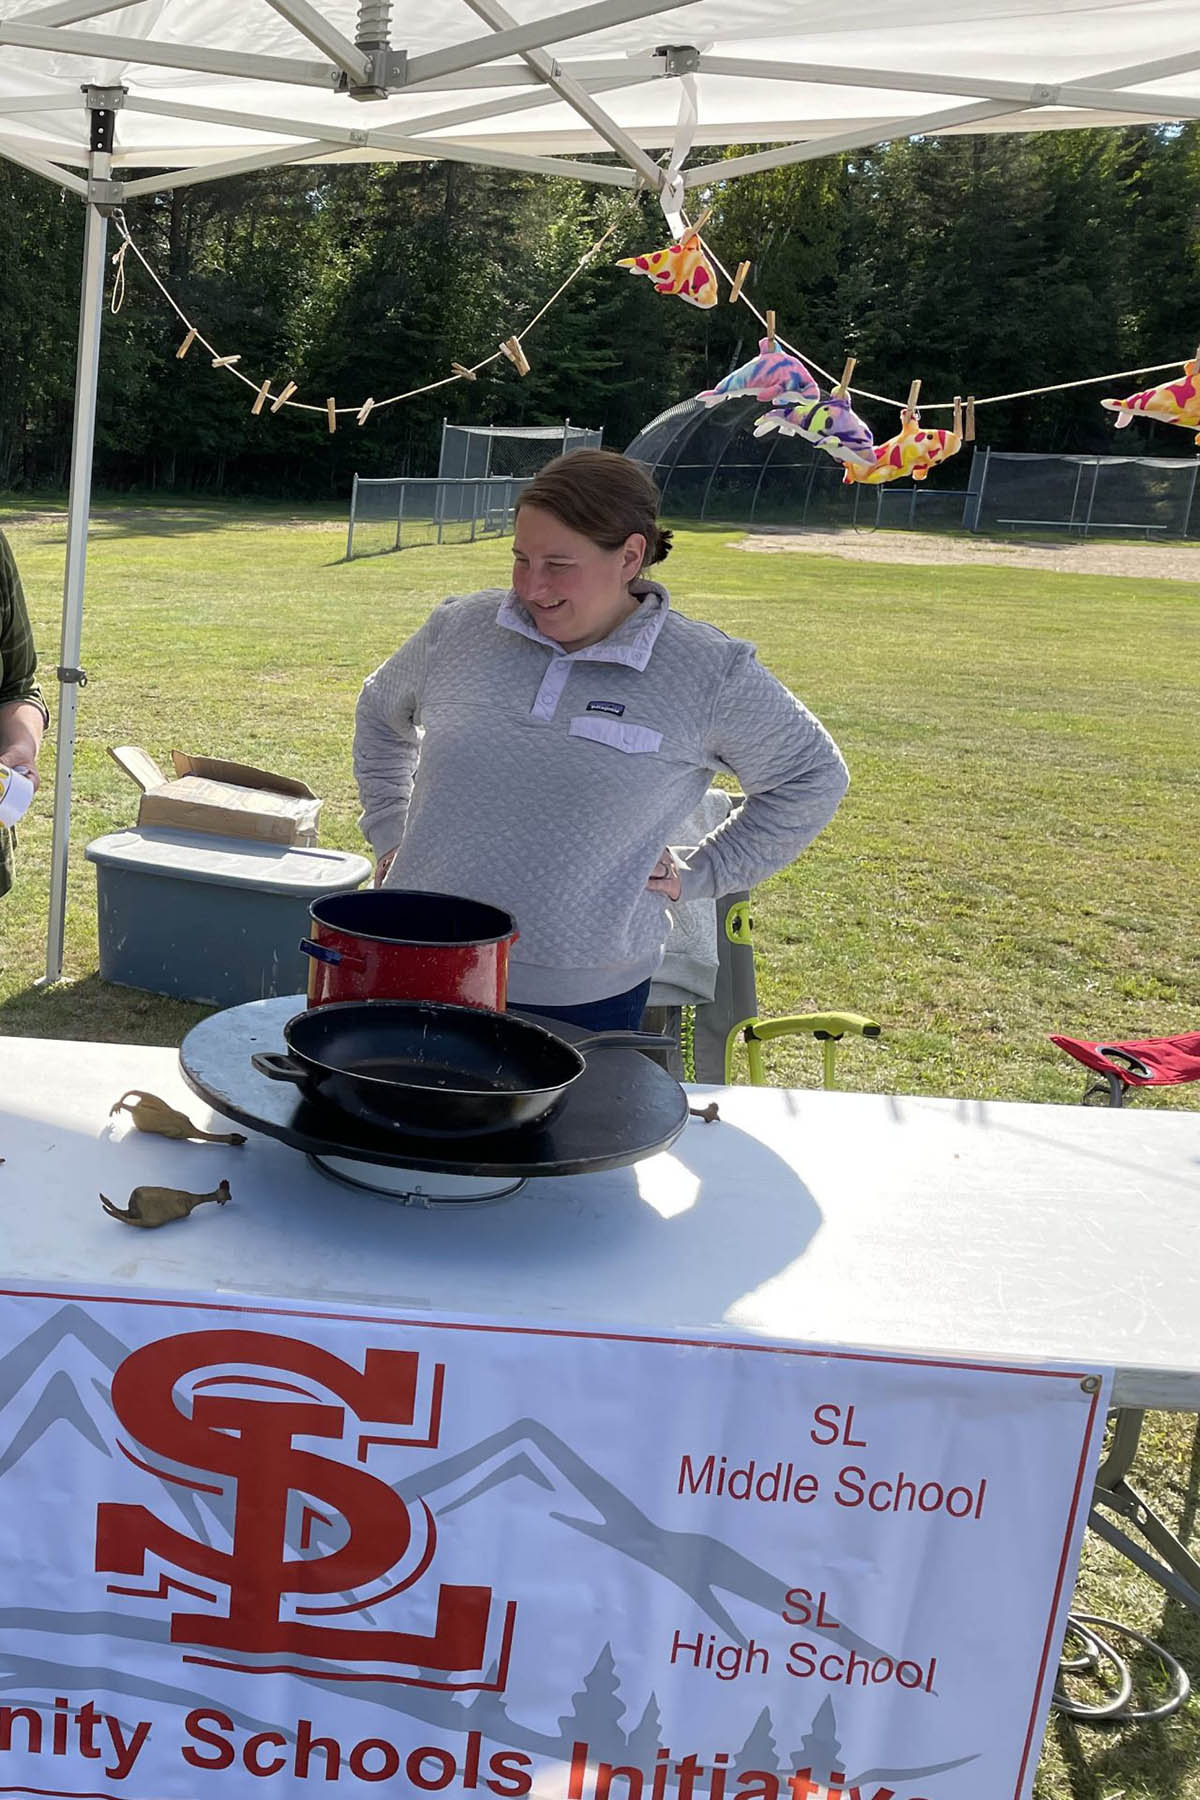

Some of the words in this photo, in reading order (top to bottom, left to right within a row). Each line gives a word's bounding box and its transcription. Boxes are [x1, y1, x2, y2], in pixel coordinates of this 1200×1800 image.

[810, 1403, 868, 1448] SL
[677, 1454, 820, 1505] Middle
[834, 1465, 987, 1521] School
[780, 1587, 841, 1630] SL
[669, 1629, 770, 1682] High
[785, 1640, 938, 1693] School
[180, 1707, 534, 1799] Schools
[566, 1740, 929, 1800] Initiati
